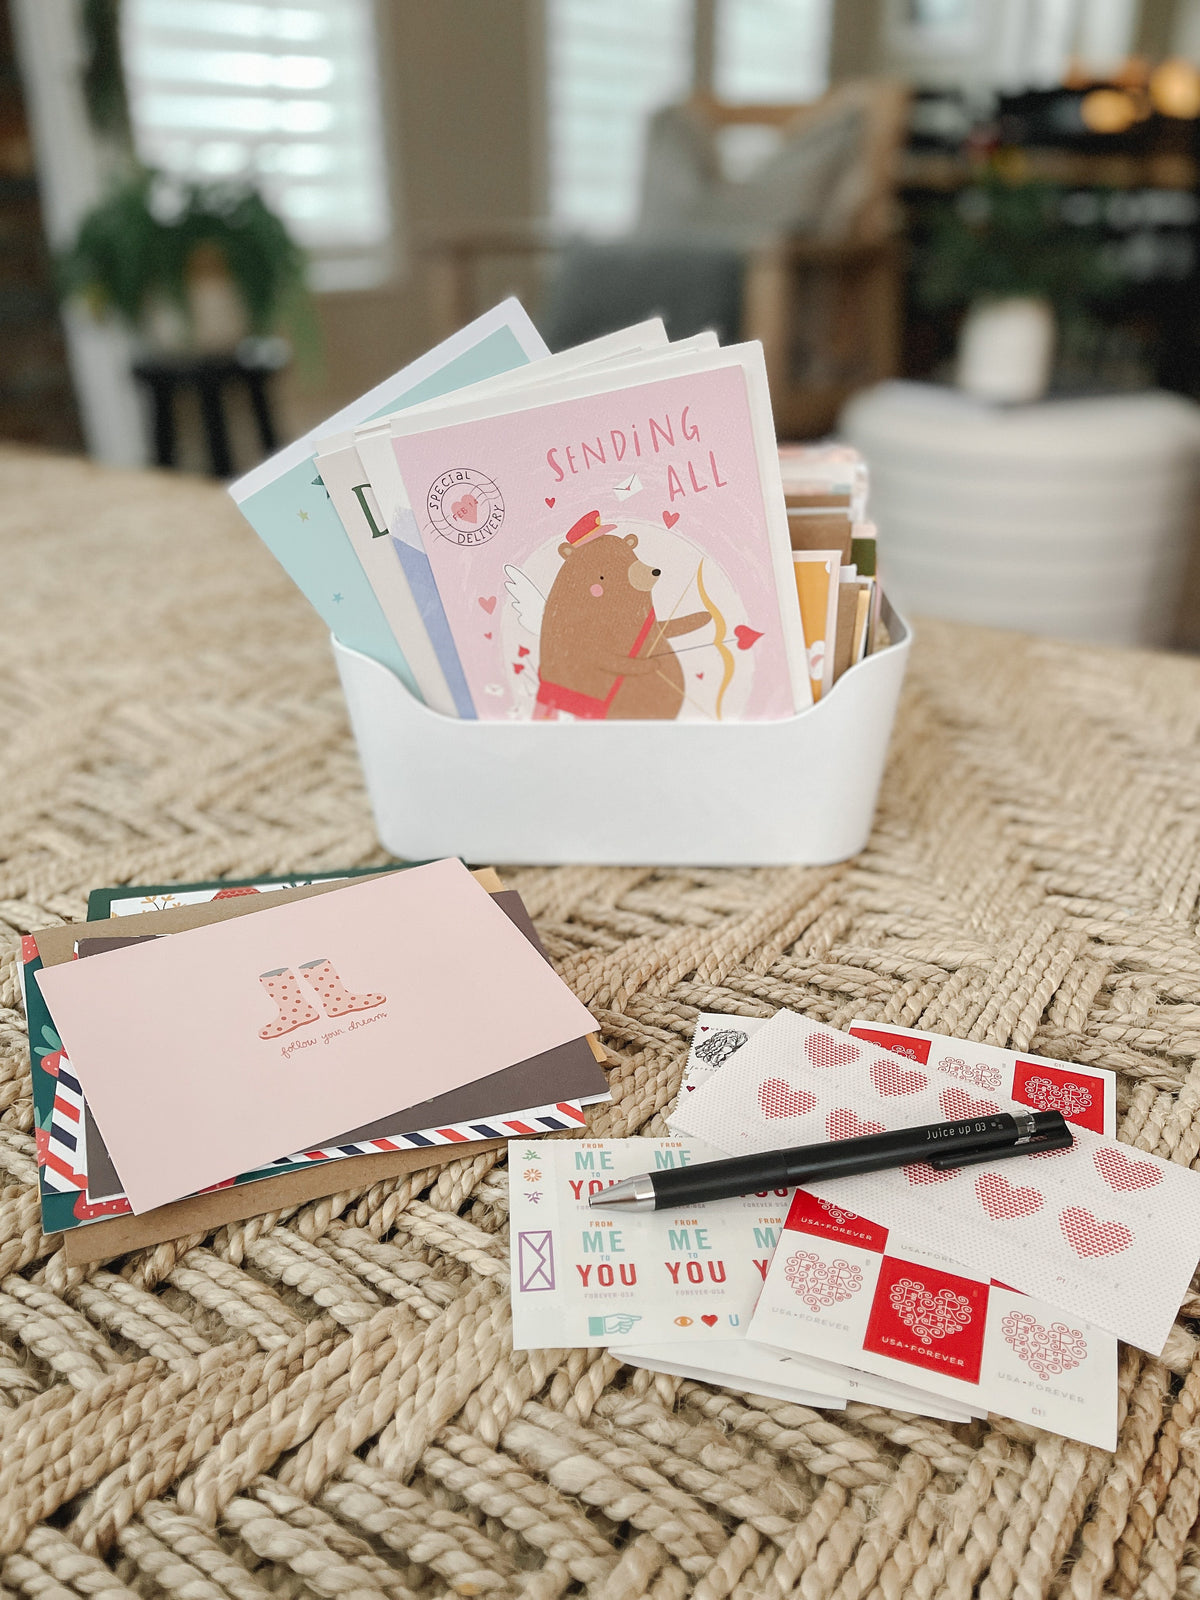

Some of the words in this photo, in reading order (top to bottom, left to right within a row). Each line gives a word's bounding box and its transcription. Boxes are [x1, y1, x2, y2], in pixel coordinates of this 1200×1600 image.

[667, 450, 727, 502] ALL
[457, 504, 505, 544] DELIVERY
[281, 1038, 317, 1059] follow
[321, 1028, 345, 1044] your
[926, 1127, 955, 1140] Juice
[958, 1125, 971, 1135] up
[974, 1121, 987, 1132] 03
[574, 1151, 614, 1170] ME
[568, 1179, 622, 1201] YO
[582, 1230, 625, 1253] ME
[667, 1228, 712, 1251] ME
[752, 1227, 784, 1249] M
[575, 1263, 637, 1288] YOU
[664, 1260, 727, 1285] YOU
[728, 1313, 740, 1327] U
